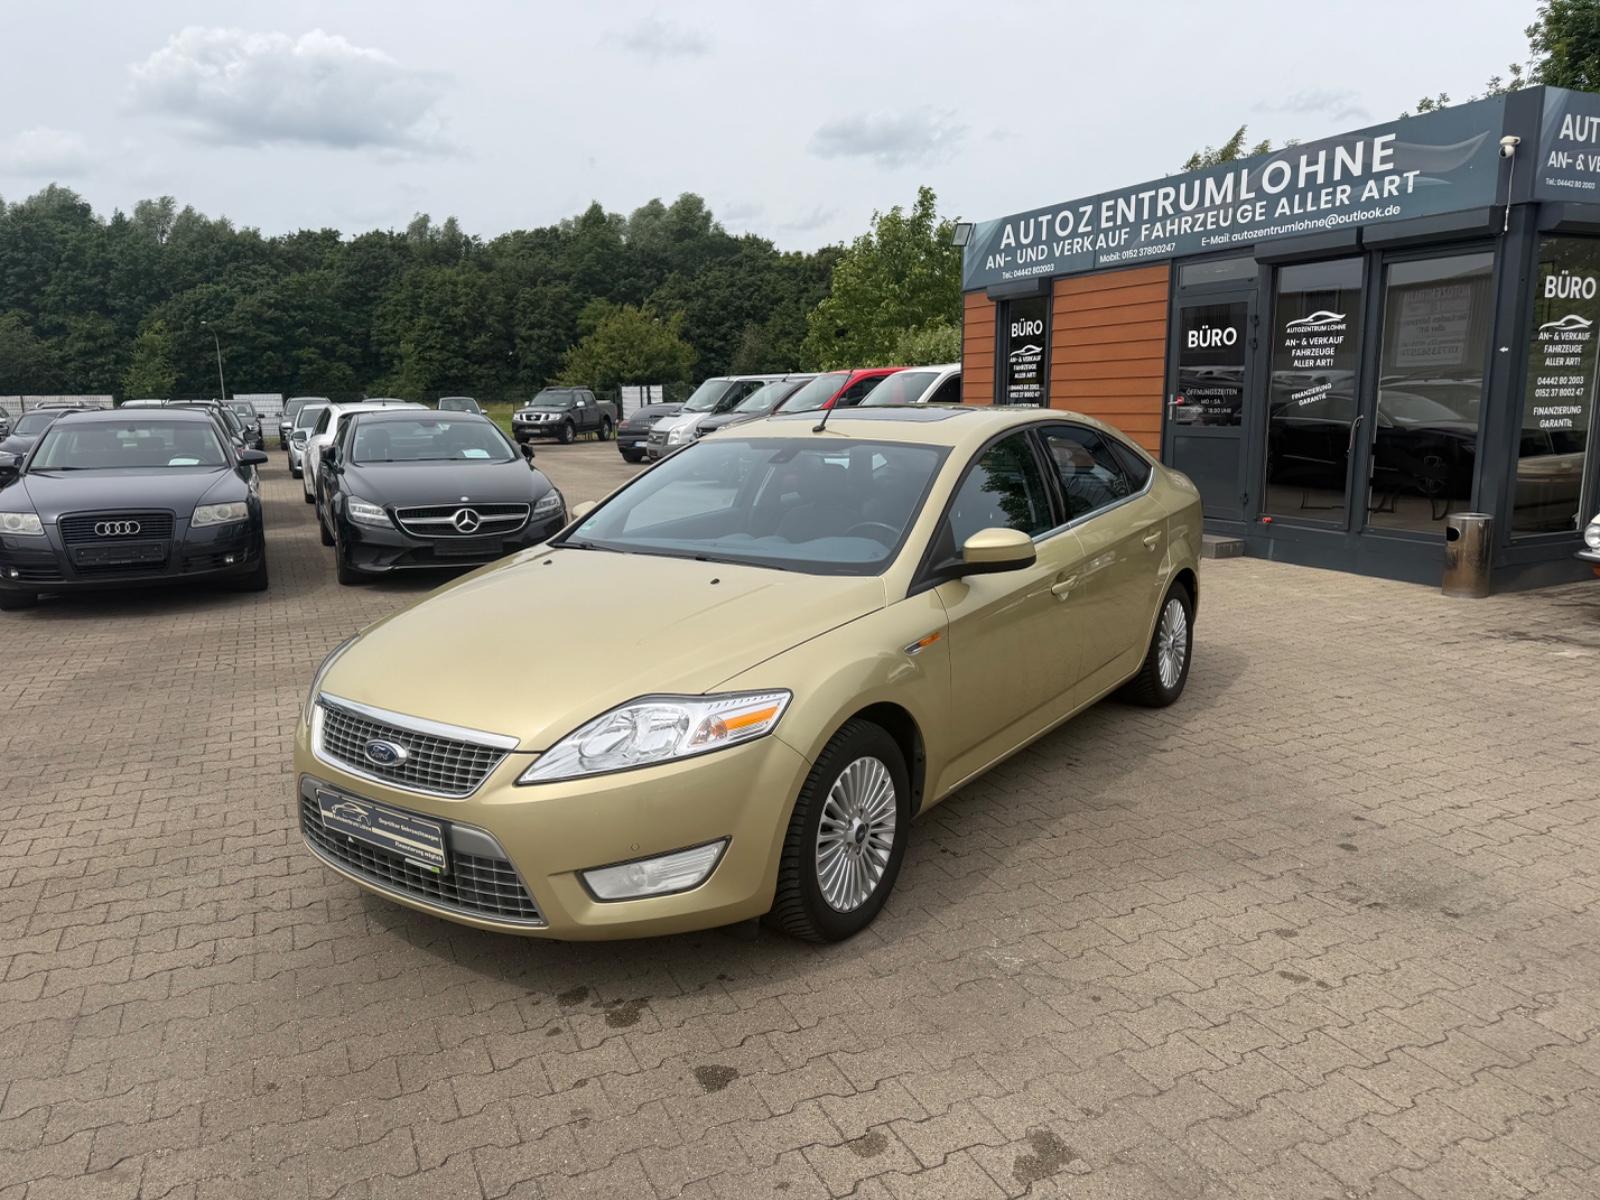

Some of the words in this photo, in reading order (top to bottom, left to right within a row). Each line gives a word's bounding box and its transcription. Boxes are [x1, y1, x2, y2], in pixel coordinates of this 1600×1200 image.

[1547, 151, 1573, 169] AN-
[1576, 154, 1584, 171] &
[985, 252, 1012, 270] AN-
[1016, 244, 1048, 264] UND
[1053, 227, 1130, 257] VERKAUF
[1140, 200, 1267, 241] FAHRZEUGE
[1274, 184, 1351, 217] ALLER
[1360, 170, 1420, 201] ART
[1231, 204, 1401, 242] autozentrumlohne@outlook.de
[1122, 249, 1138, 260] 0152
[1139, 242, 1176, 257] 37800247
[1013, 268, 1031, 278] 04442
[1544, 270, 1597, 300] BÜRO
[1011, 318, 1043, 337] BÜRO
[1286, 325, 1327, 333] AUTOZENTRUM
[1188, 325, 1237, 348] BÜRO
[1285, 338, 1300, 347] AN-
[1301, 337, 1307, 346] &
[1309, 335, 1345, 345] VERKAUF
[1538, 332, 1553, 341] AN-
[1553, 332, 1559, 341] &
[1560, 331, 1591, 341] VERKAUF
[1291, 347, 1335, 357] FAHRZEUGE
[1543, 344, 1583, 354] FAHRZEUGE
[1293, 359, 1314, 367] ALLER
[1315, 358, 1334, 367] ART!
[1544, 357, 1565, 366] ALLER
[1565, 357, 1581, 366] ART!
[1537, 376, 1558, 385] 04442
[1559, 376, 1567, 385] 80
[1568, 375, 1584, 384] 2003
[1291, 382, 1332, 400] FINANZIERUNG
[1535, 388, 1550, 397] 0152
[1550, 388, 1559, 397] 37
[1559, 388, 1575, 397] 8002
[1575, 387, 1584, 396] 47
[1533, 406, 1582, 416] FINANZIERUNG
